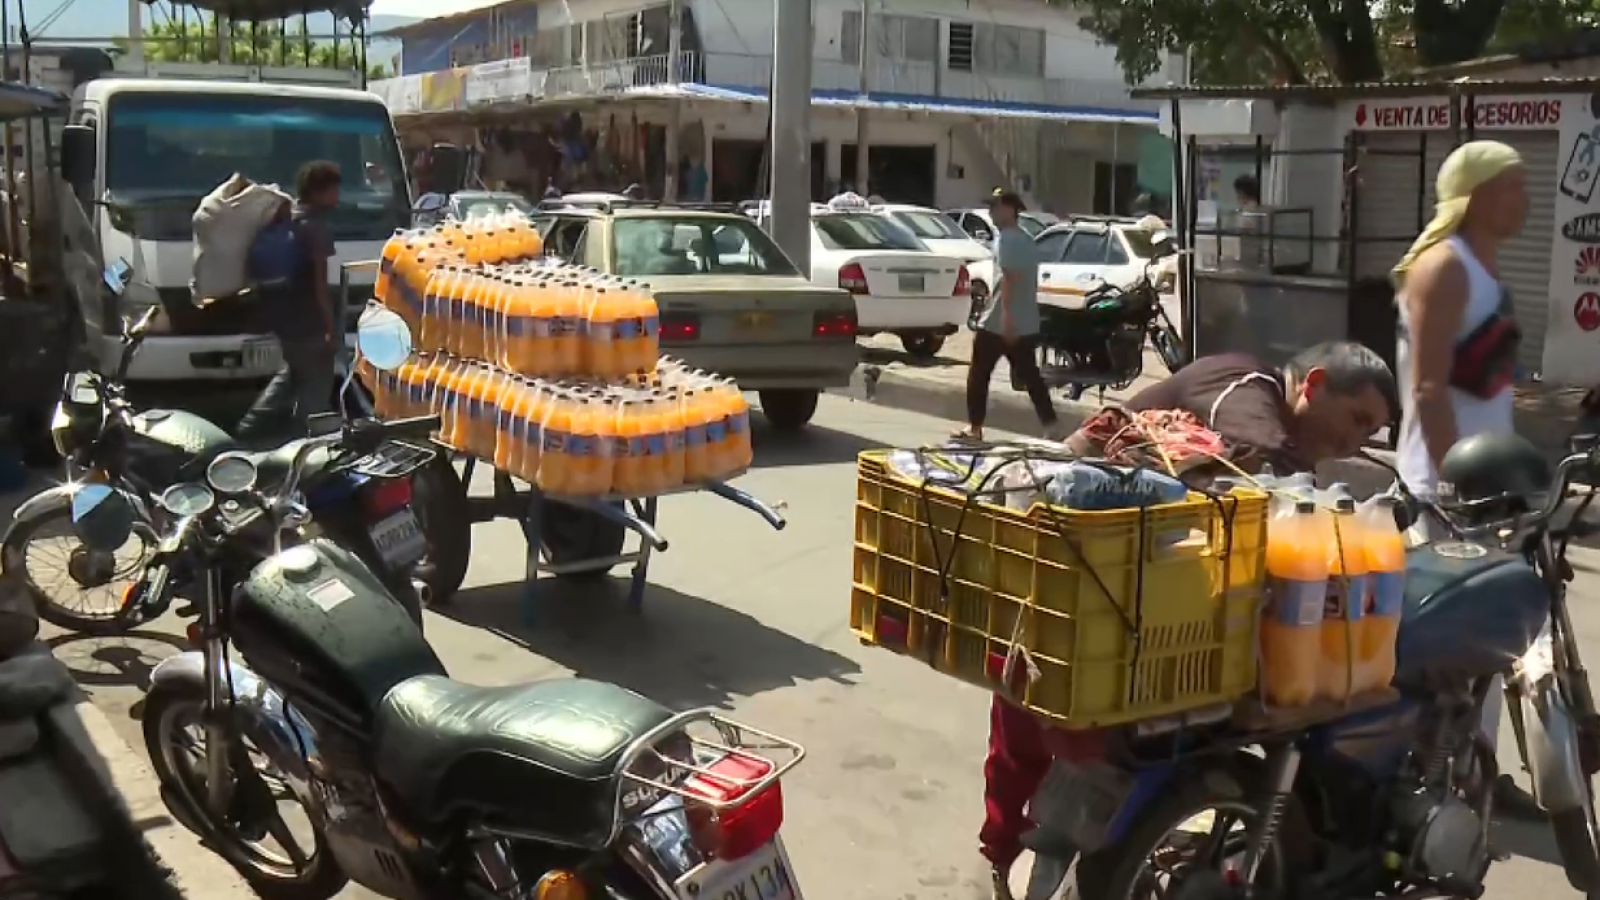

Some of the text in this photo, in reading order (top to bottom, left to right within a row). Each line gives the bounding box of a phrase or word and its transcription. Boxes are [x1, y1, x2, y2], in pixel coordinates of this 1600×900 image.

[1374, 100, 1562, 127] VENTA DE CESORIOS
